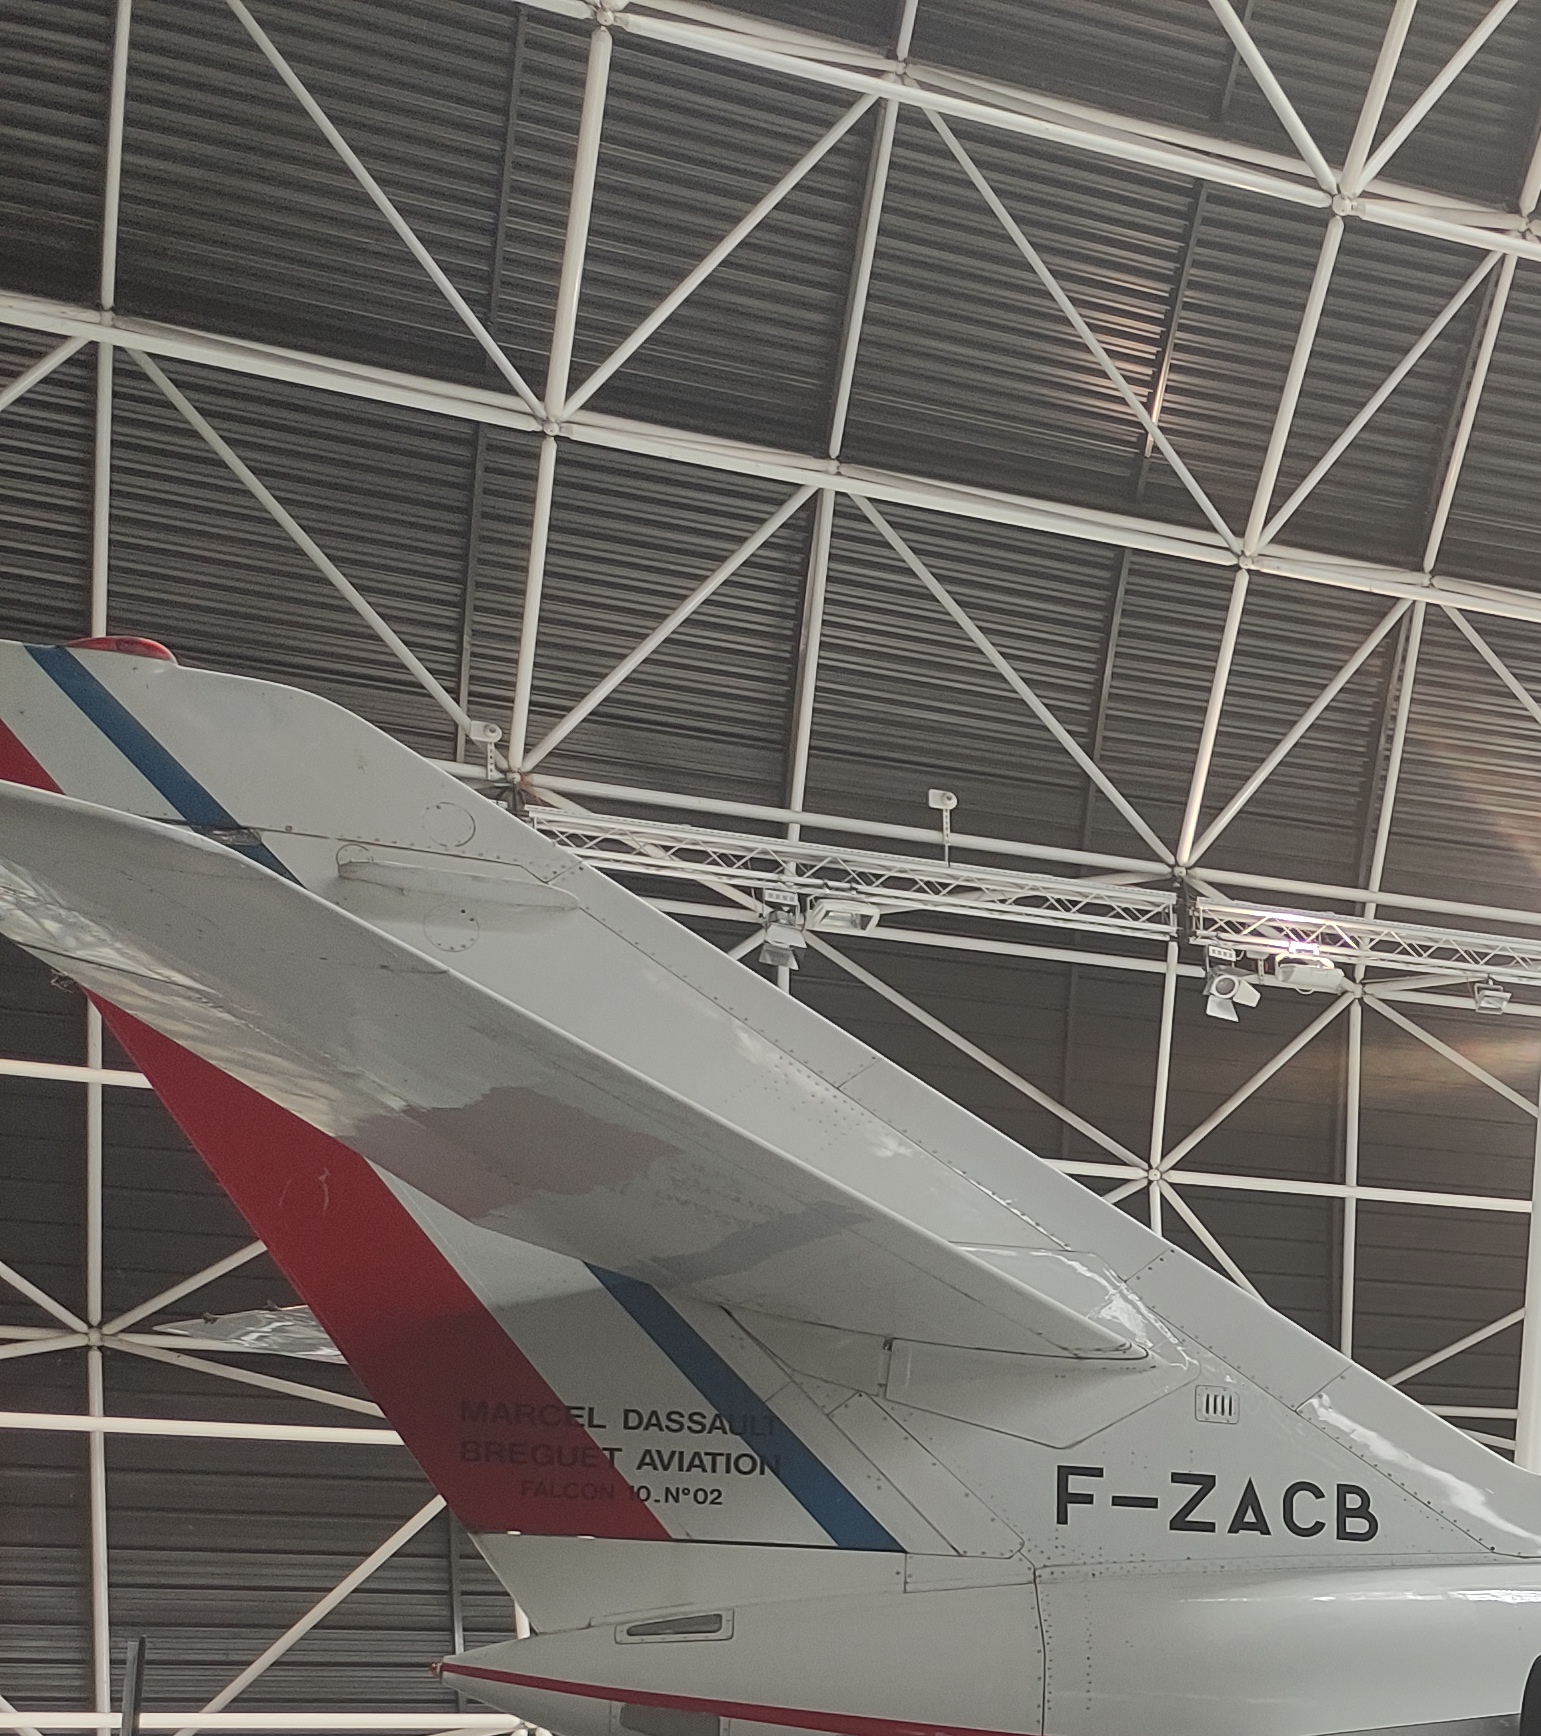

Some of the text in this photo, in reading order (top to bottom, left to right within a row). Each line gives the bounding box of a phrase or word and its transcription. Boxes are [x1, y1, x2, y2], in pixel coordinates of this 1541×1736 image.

[460, 1399, 775, 1438] MARCEL DASSAULT
[460, 1439, 781, 1476] BREGUET AVIATION
[521, 1481, 615, 1501] FALCON
[1056, 1464, 1379, 1542] F-ZACB
